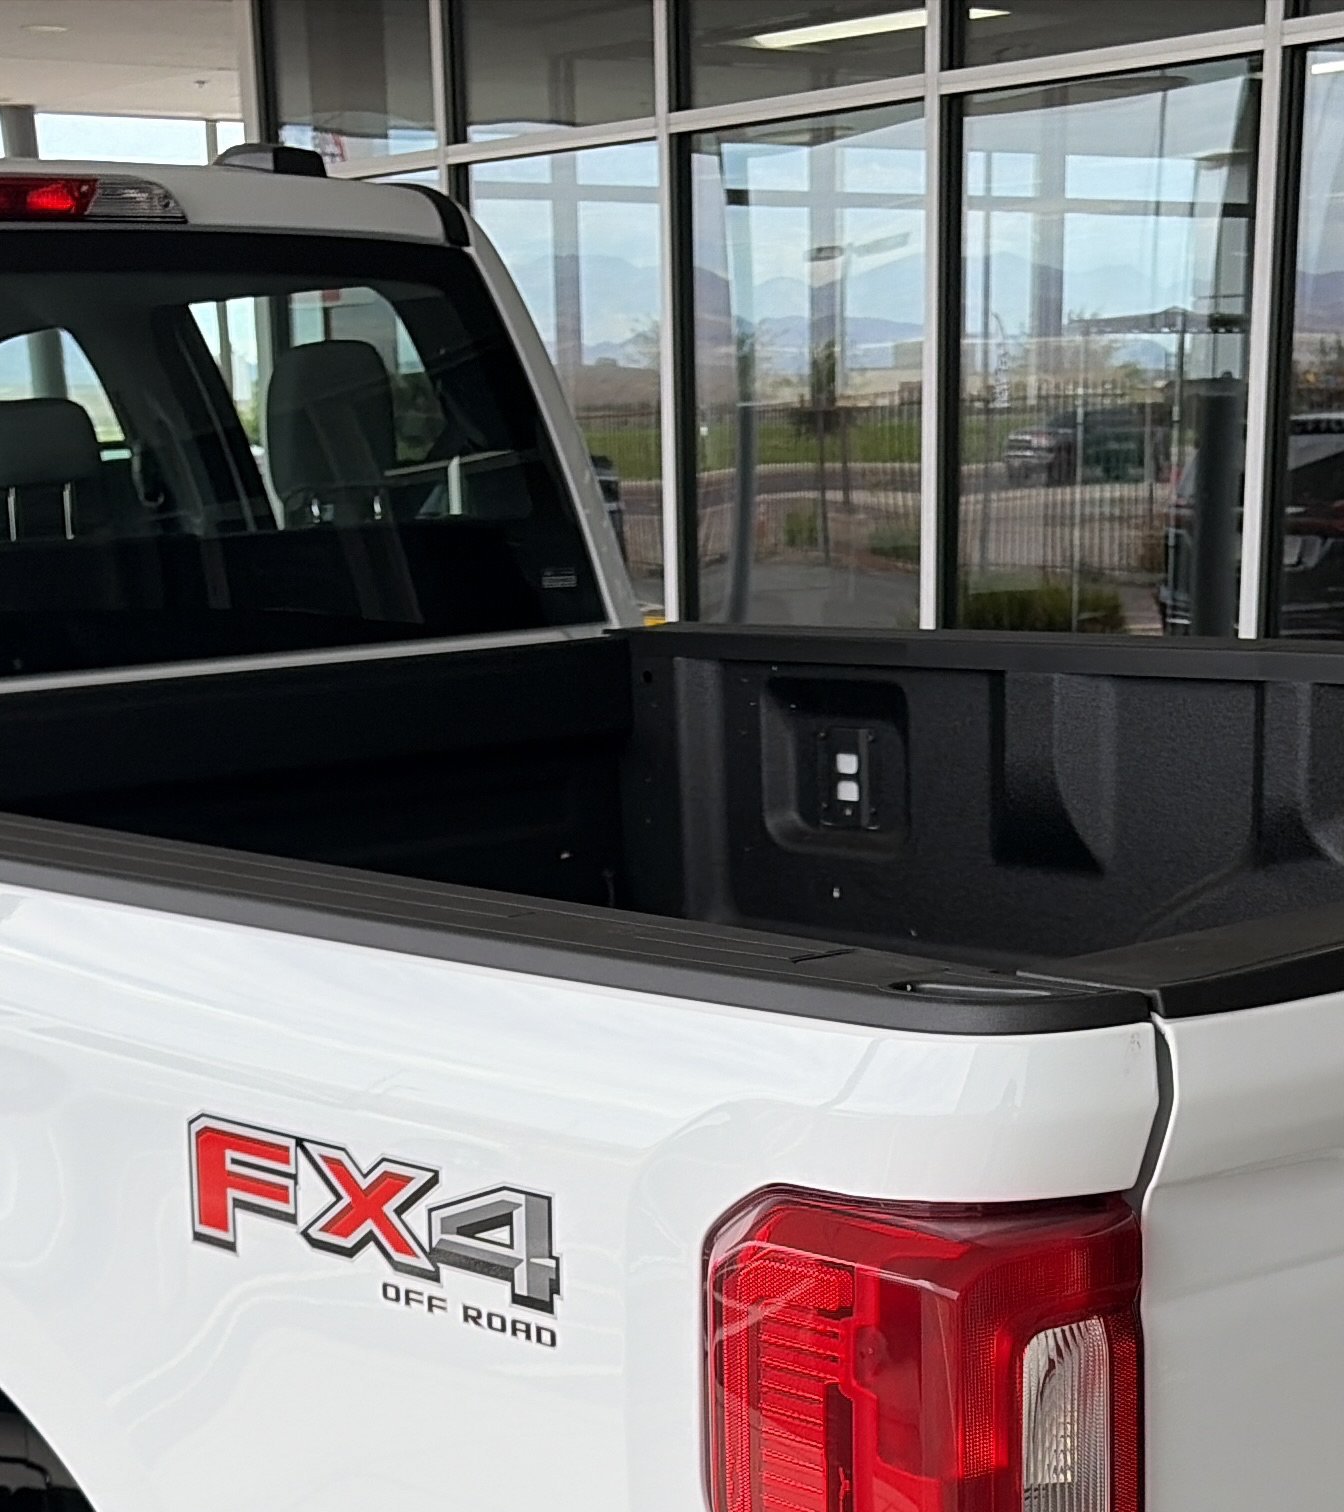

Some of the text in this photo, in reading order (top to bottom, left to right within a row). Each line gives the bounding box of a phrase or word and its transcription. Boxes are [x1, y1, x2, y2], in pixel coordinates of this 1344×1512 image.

[187, 1111, 562, 1318] FX4
[381, 1281, 558, 1349] OFF ROAD
